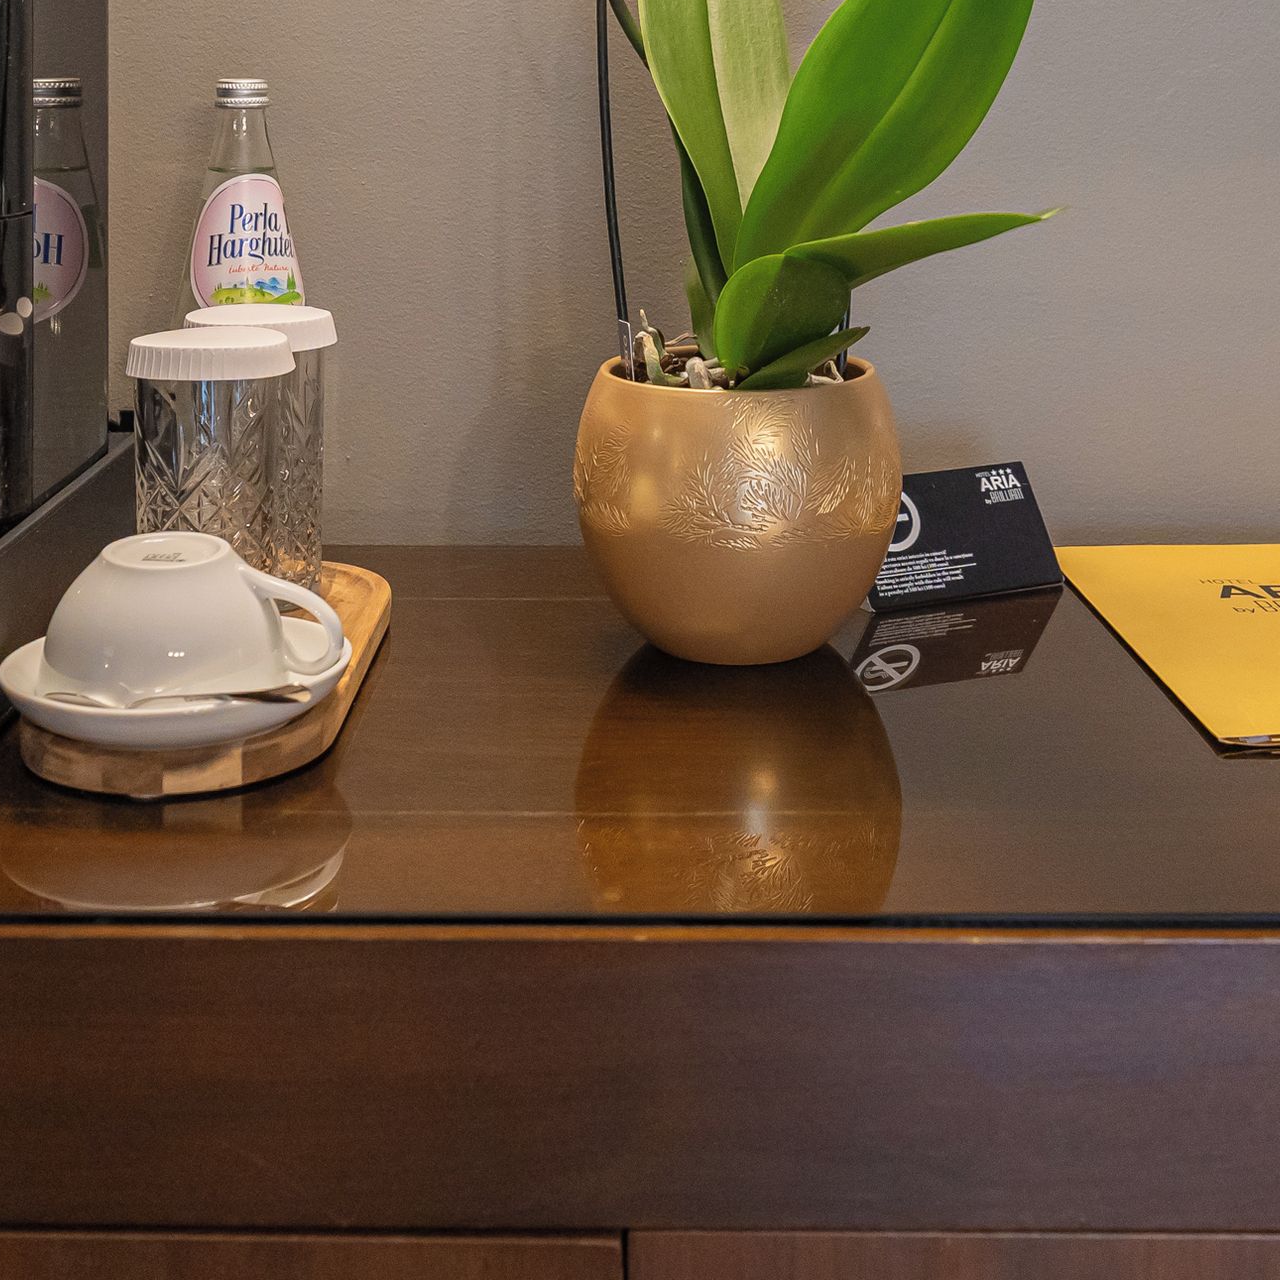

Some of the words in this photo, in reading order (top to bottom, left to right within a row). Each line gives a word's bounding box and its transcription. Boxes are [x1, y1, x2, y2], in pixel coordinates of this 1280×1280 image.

[229, 203, 280, 234] Perla
[980, 473, 1021, 492] ARIA
[1233, 606, 1255, 614] by
